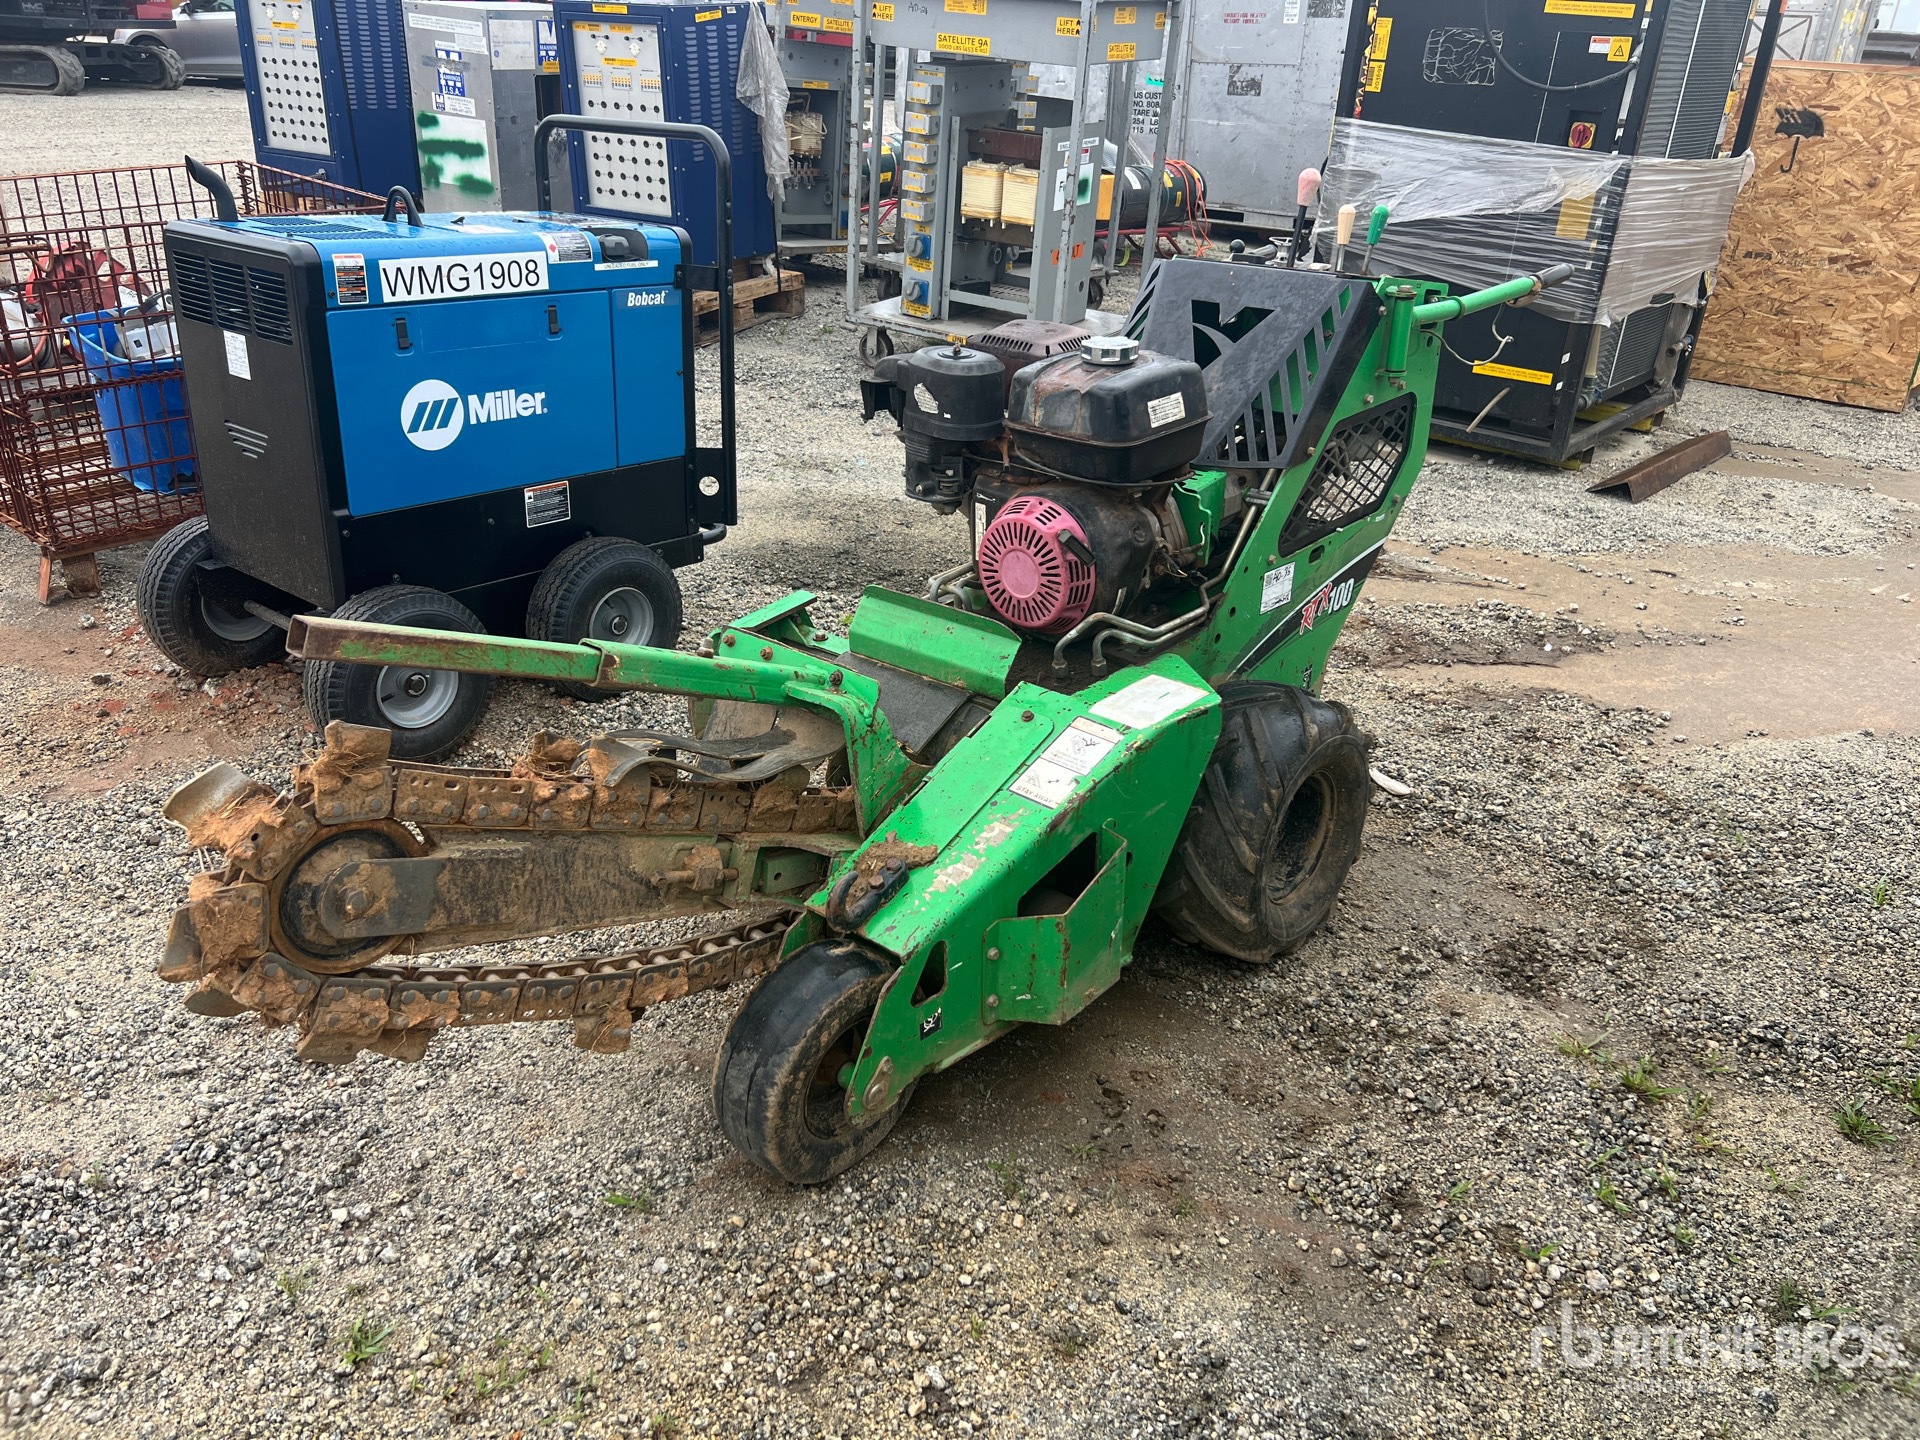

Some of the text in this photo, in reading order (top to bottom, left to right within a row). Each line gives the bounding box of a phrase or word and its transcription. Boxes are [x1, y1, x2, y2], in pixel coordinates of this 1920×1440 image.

[792, 14, 817, 24] ENTERGY
[826, 19, 850, 27] SATELLITE
[938, 35, 988, 47] SATELLITE 9A
[382, 258, 540, 297] WMG1908
[627, 290, 666, 307] Bobcat
[467, 389, 546, 425] Miller
[1016, 785, 1032, 795] STAY
